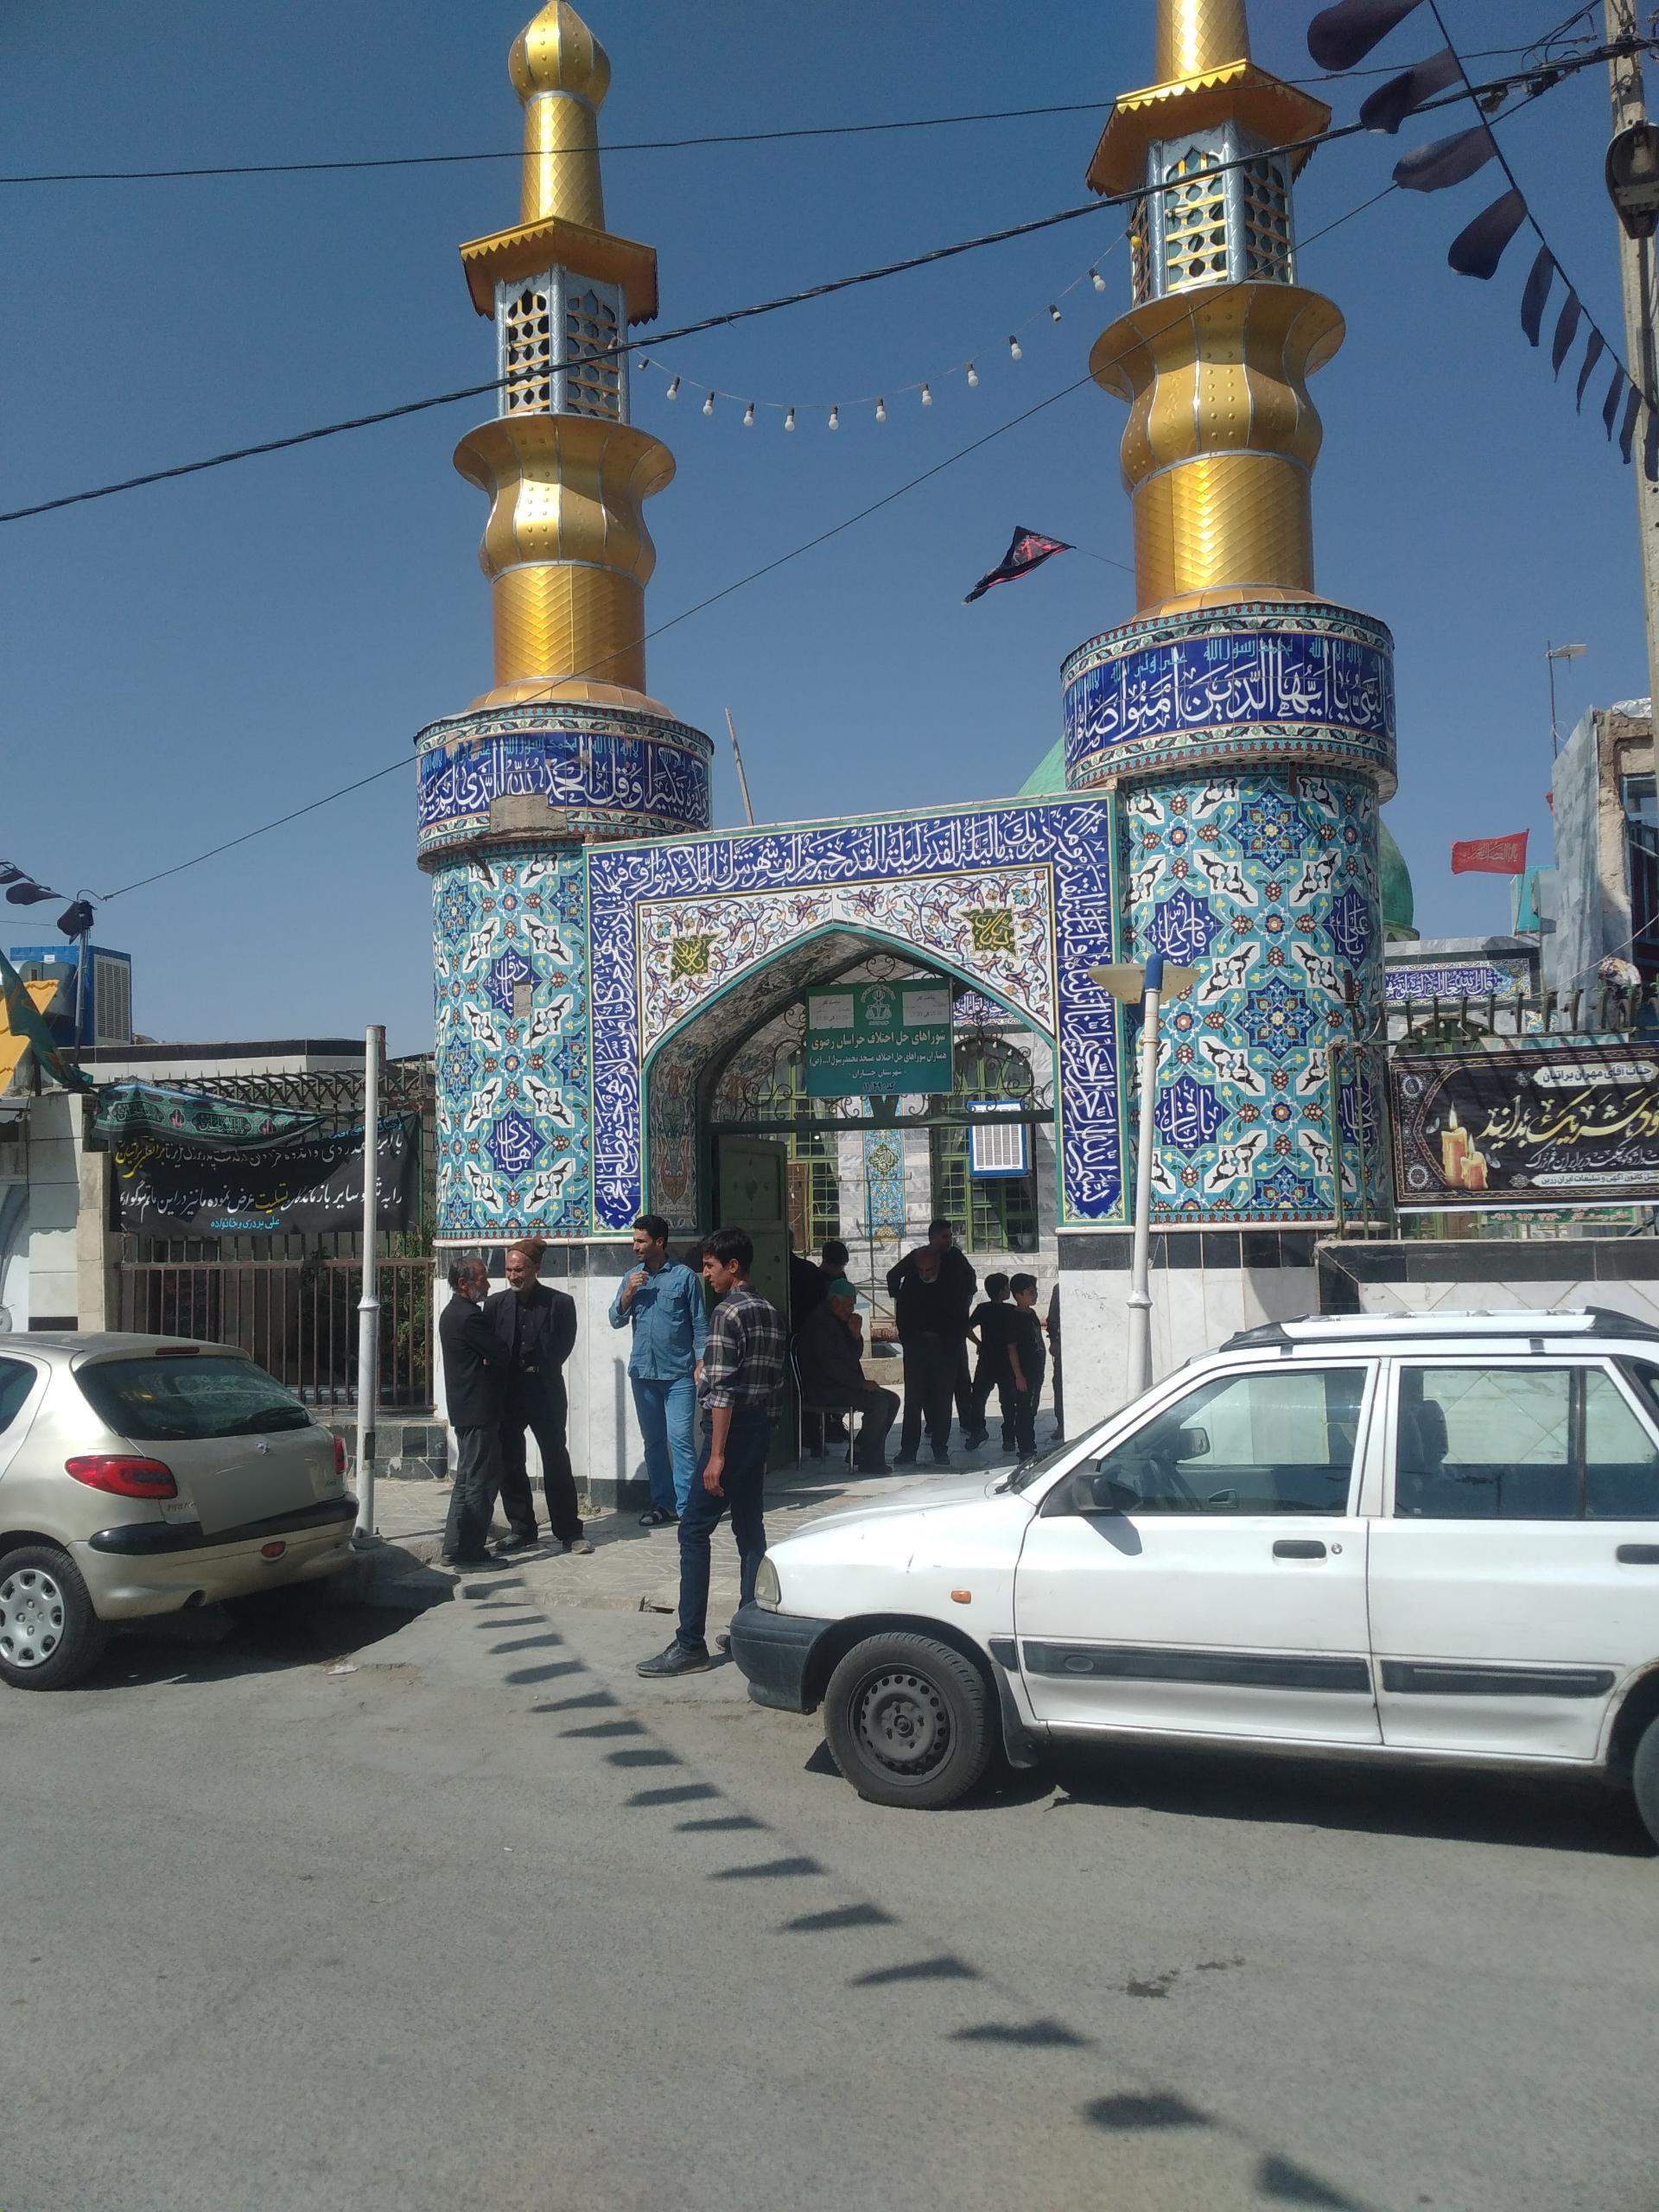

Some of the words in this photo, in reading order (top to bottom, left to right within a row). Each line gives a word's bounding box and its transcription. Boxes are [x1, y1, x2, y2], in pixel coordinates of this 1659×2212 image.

[812, 1039, 836, 1051] رضوی
[836, 1033, 865, 1049] خراسان
[867, 1032, 894, 1045] اختلاف
[895, 1031, 909, 1046] حل
[911, 1029, 946, 1046] شوراهای
[858, 1054, 874, 1065] مسجد
[875, 1052, 894, 1064] اختلاف
[893, 1052, 904, 1063] حل
[1574, 1070, 1603, 1081] مهران
[1603, 1064, 1624, 1080] آقای
[1625, 1064, 1652, 1080] جناب
[226, 1187, 255, 1214] عرض
[254, 1183, 289, 1214] تسلیت
[332, 1183, 359, 1209] سایر
[210, 1217, 238, 1230] خانواده
